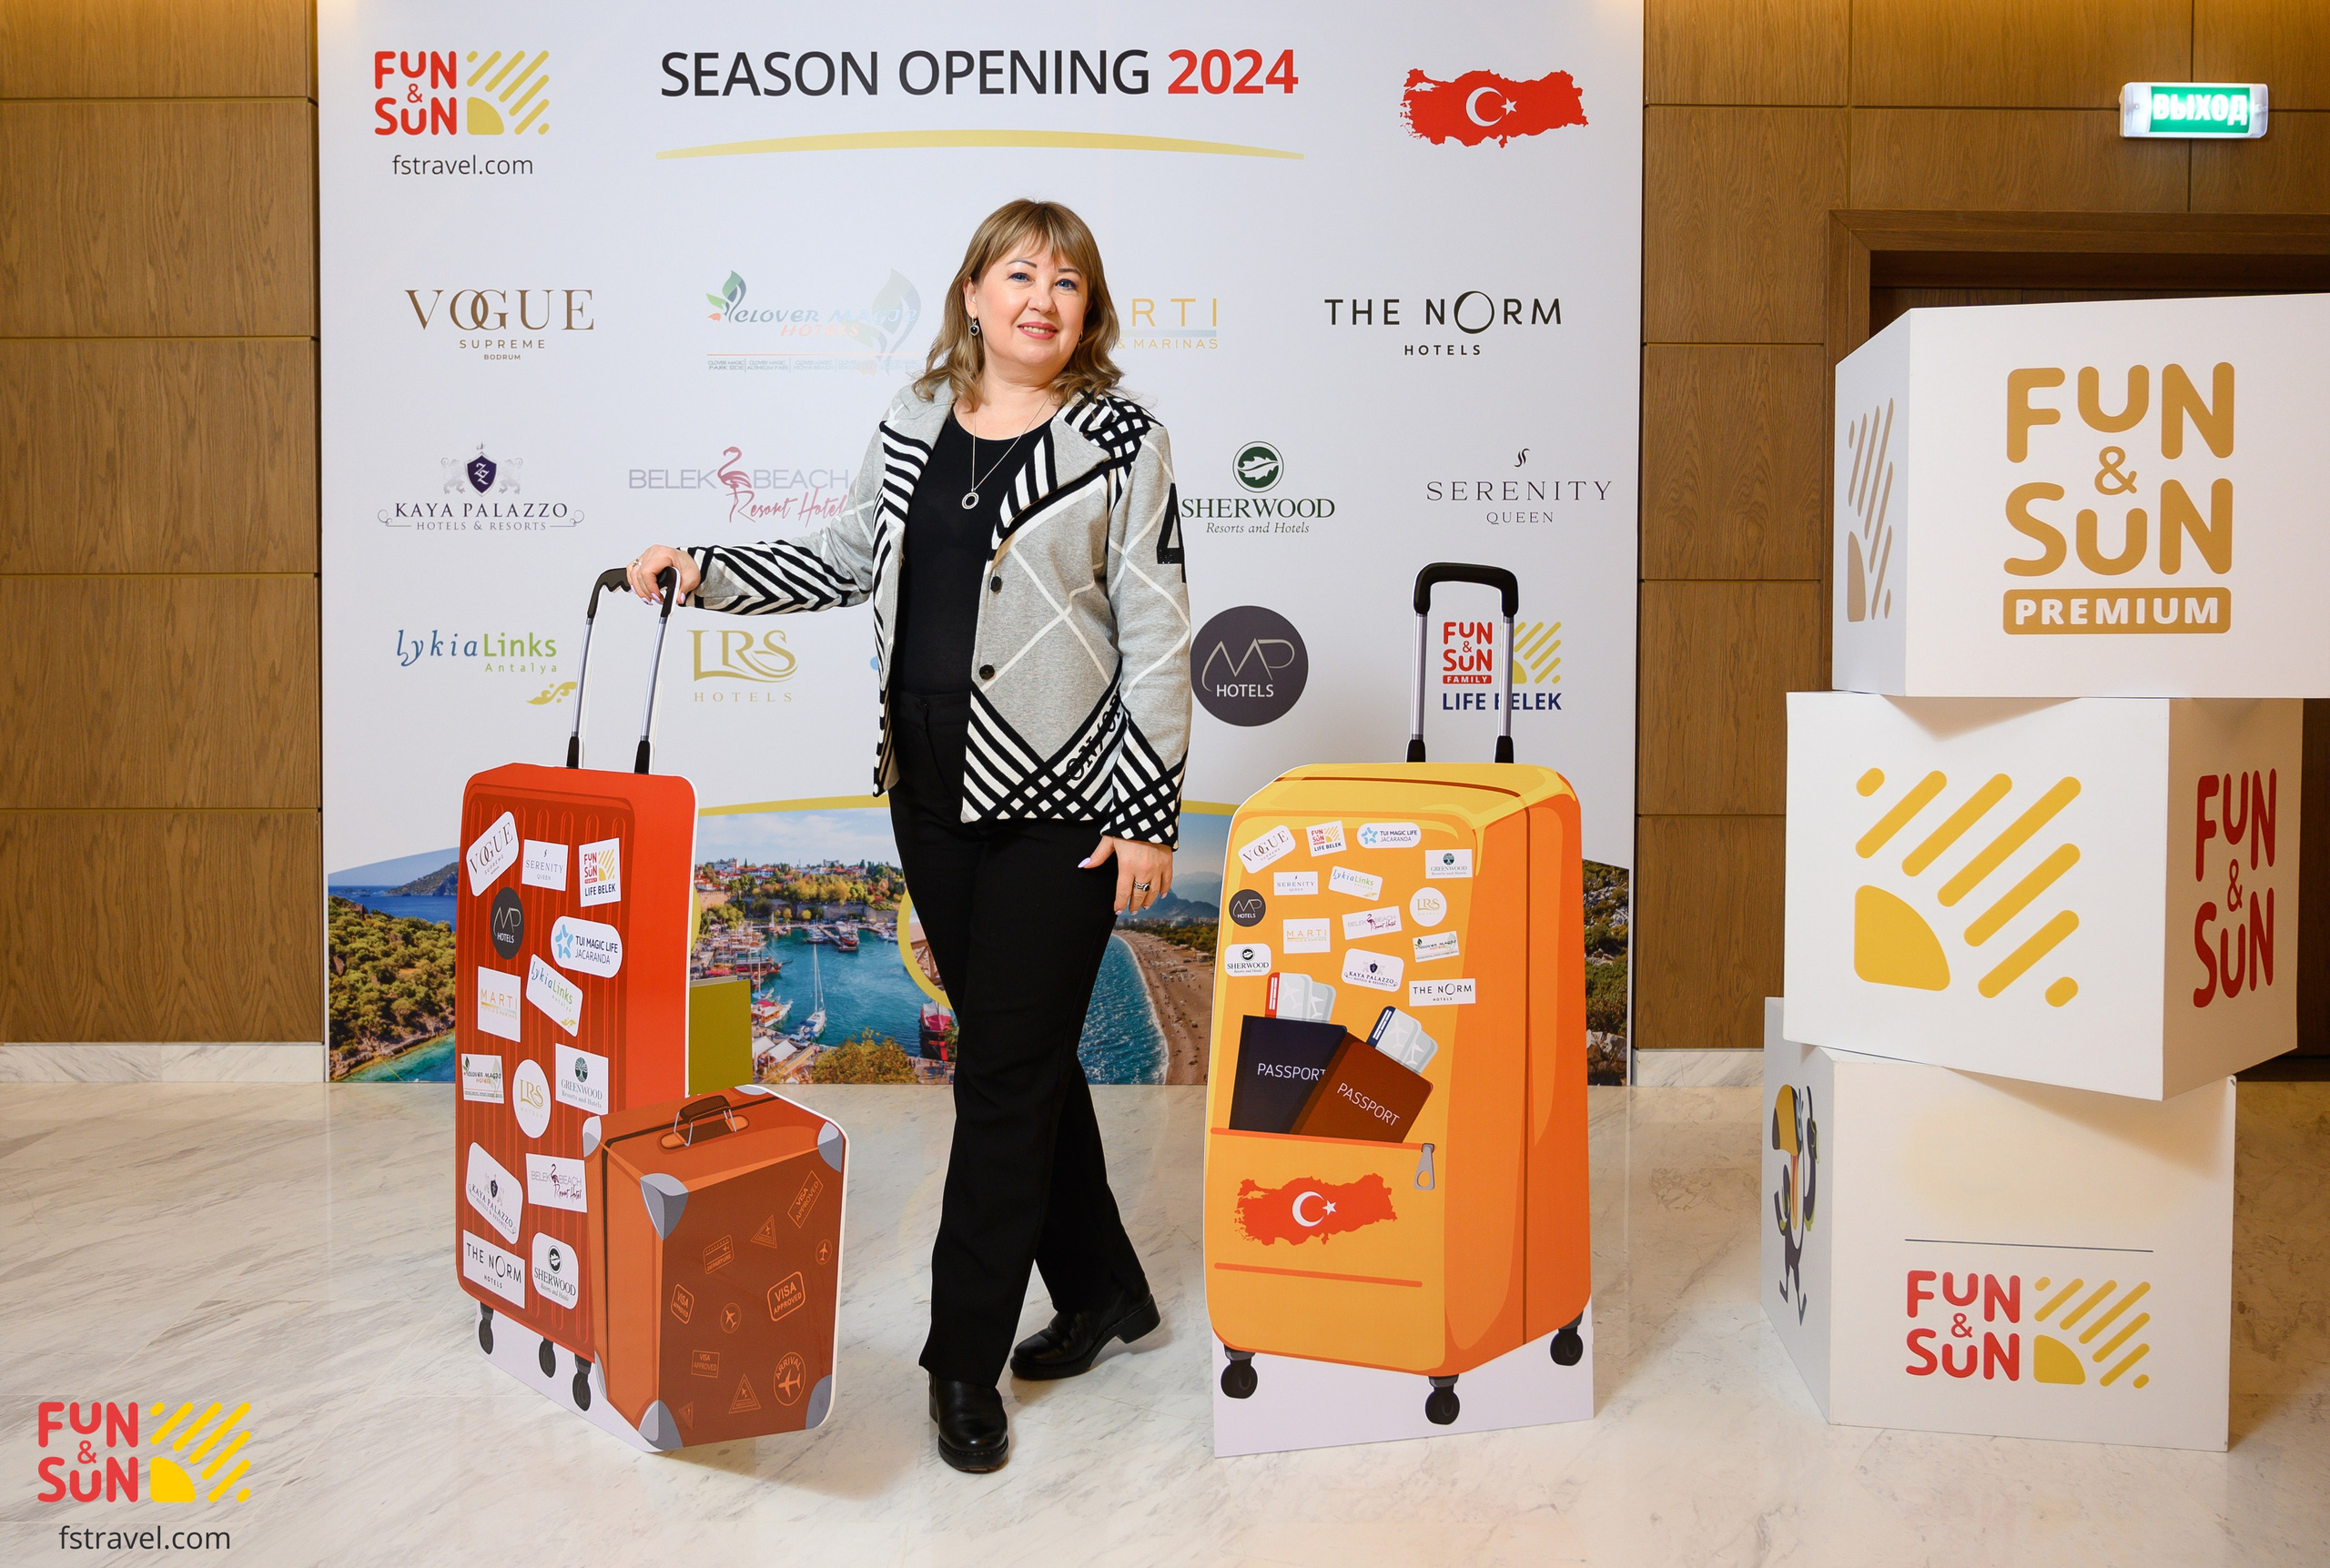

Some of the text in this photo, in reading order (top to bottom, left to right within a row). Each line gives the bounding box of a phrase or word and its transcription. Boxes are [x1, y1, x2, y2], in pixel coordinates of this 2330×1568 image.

[374, 50, 457, 90] FUN
[661, 48, 1299, 97] SEASON OPENING 2024
[407, 83, 423, 104] &
[374, 96, 457, 136] SUN
[2153, 94, 2248, 126] ВЫХОД
[392, 154, 533, 176] fstravel.com
[405, 288, 594, 331] VOGUE
[734, 309, 917, 323] CLOVER MAGIC
[1131, 298, 1217, 327] RTI
[1324, 290, 1562, 335] THE NORM
[780, 324, 860, 337] HOTELS
[460, 339, 546, 349] SUPREME
[1134, 339, 1219, 349] MARINAS
[1404, 345, 1482, 356] HOTELS
[2007, 362, 2234, 463] FUN
[629, 469, 848, 490] BELEK BEACH
[2094, 446, 2137, 496] &
[1426, 481, 1613, 501] SERENITY
[395, 502, 568, 518] KAYA PALAZZO
[730, 487, 847, 528] Resort Hotel
[1181, 498, 1335, 518] SHERWOOD
[417, 521, 546, 531] HOTELS & RESORTS
[1206, 522, 1310, 534] Resorts and Hotels
[1486, 511, 1554, 525] QUEEN
[2003, 478, 2233, 576] SUN
[2015, 597, 2219, 626] PREMIUM
[1443, 622, 1493, 644] FUN
[686, 630, 799, 683] LRS
[1463, 641, 1473, 653] &
[485, 663, 557, 674] Antalya
[1443, 649, 1493, 672] SUN
[694, 693, 792, 703] HOTELS
[1216, 684, 1274, 698] HOTELS
[1443, 693, 1487, 710] LIFE
[1311, 828, 1323, 836] FUN
[2195, 768, 2276, 882] FUN
[470, 822, 513, 875] VOGUE
[1242, 830, 1289, 862] VOGUE
[1326, 842, 1342, 850] BELEK
[525, 860, 563, 874] SERENITY
[583, 852, 597, 865] FUN
[584, 883, 616, 896] LIFE BELEK
[2227, 858, 2243, 912] &
[1417, 898, 1440, 911] LRS
[497, 932, 514, 944] HOTELS
[1287, 929, 1327, 937] MARTI
[575, 936, 618, 954] TUI MAGIC LIFE
[2193, 887, 2274, 1008] SUN
[575, 948, 611, 965] JACARANDA
[1227, 962, 1270, 970] SHERWOOD
[1349, 970, 1365, 978] KAYA
[1366, 975, 1394, 984] PALAZZO
[481, 988, 518, 1007] MARTI
[1437, 983, 1473, 996] NORM
[1257, 1062, 1326, 1081] PASSPORT
[520, 1079, 543, 1108] LRS
[561, 1079, 603, 1100] GREENWOOD
[1337, 1082, 1400, 1127] PASSPORT
[531, 1170, 582, 1187] BELEK BEACH
[471, 1185, 513, 1228] KAYA PALAZZO
[795, 1188, 809, 1206] VISA
[795, 1180, 819, 1221] APPROVED
[466, 1242, 522, 1284] THE NORM
[706, 1254, 732, 1271] DEPARTURE
[484, 1274, 502, 1289] HOTELS
[533, 1267, 576, 1296] SHERWOOD
[775, 1281, 797, 1302] VISA
[677, 1290, 689, 1309] VISA
[774, 1291, 802, 1315] APPROVED
[1907, 1270, 2021, 1323] FUN
[1950, 1312, 1973, 1339] &
[1906, 1328, 2020, 1381] SUN
[694, 1361, 717, 1371] APPROVED
[775, 1356, 802, 1380] ARRIVAL
